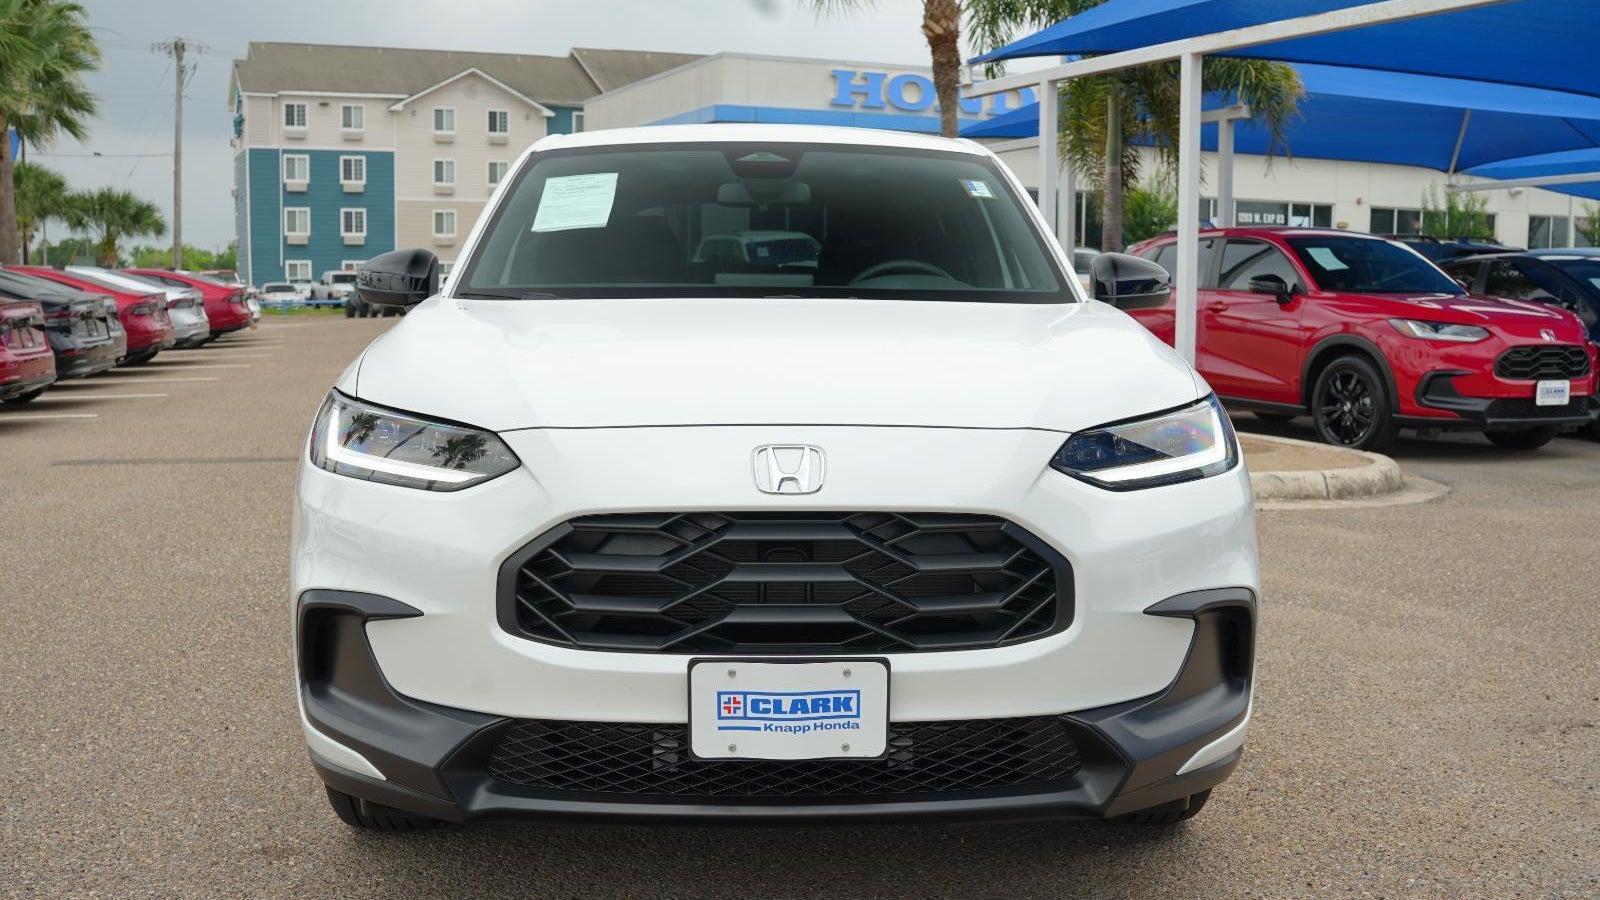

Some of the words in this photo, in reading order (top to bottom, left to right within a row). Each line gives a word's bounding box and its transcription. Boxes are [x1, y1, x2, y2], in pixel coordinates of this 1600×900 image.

[1263, 213, 1275, 224] EXP
[751, 697, 853, 714] CLARK
[764, 722, 811, 734] Knapp
[814, 721, 860, 731] Honda
